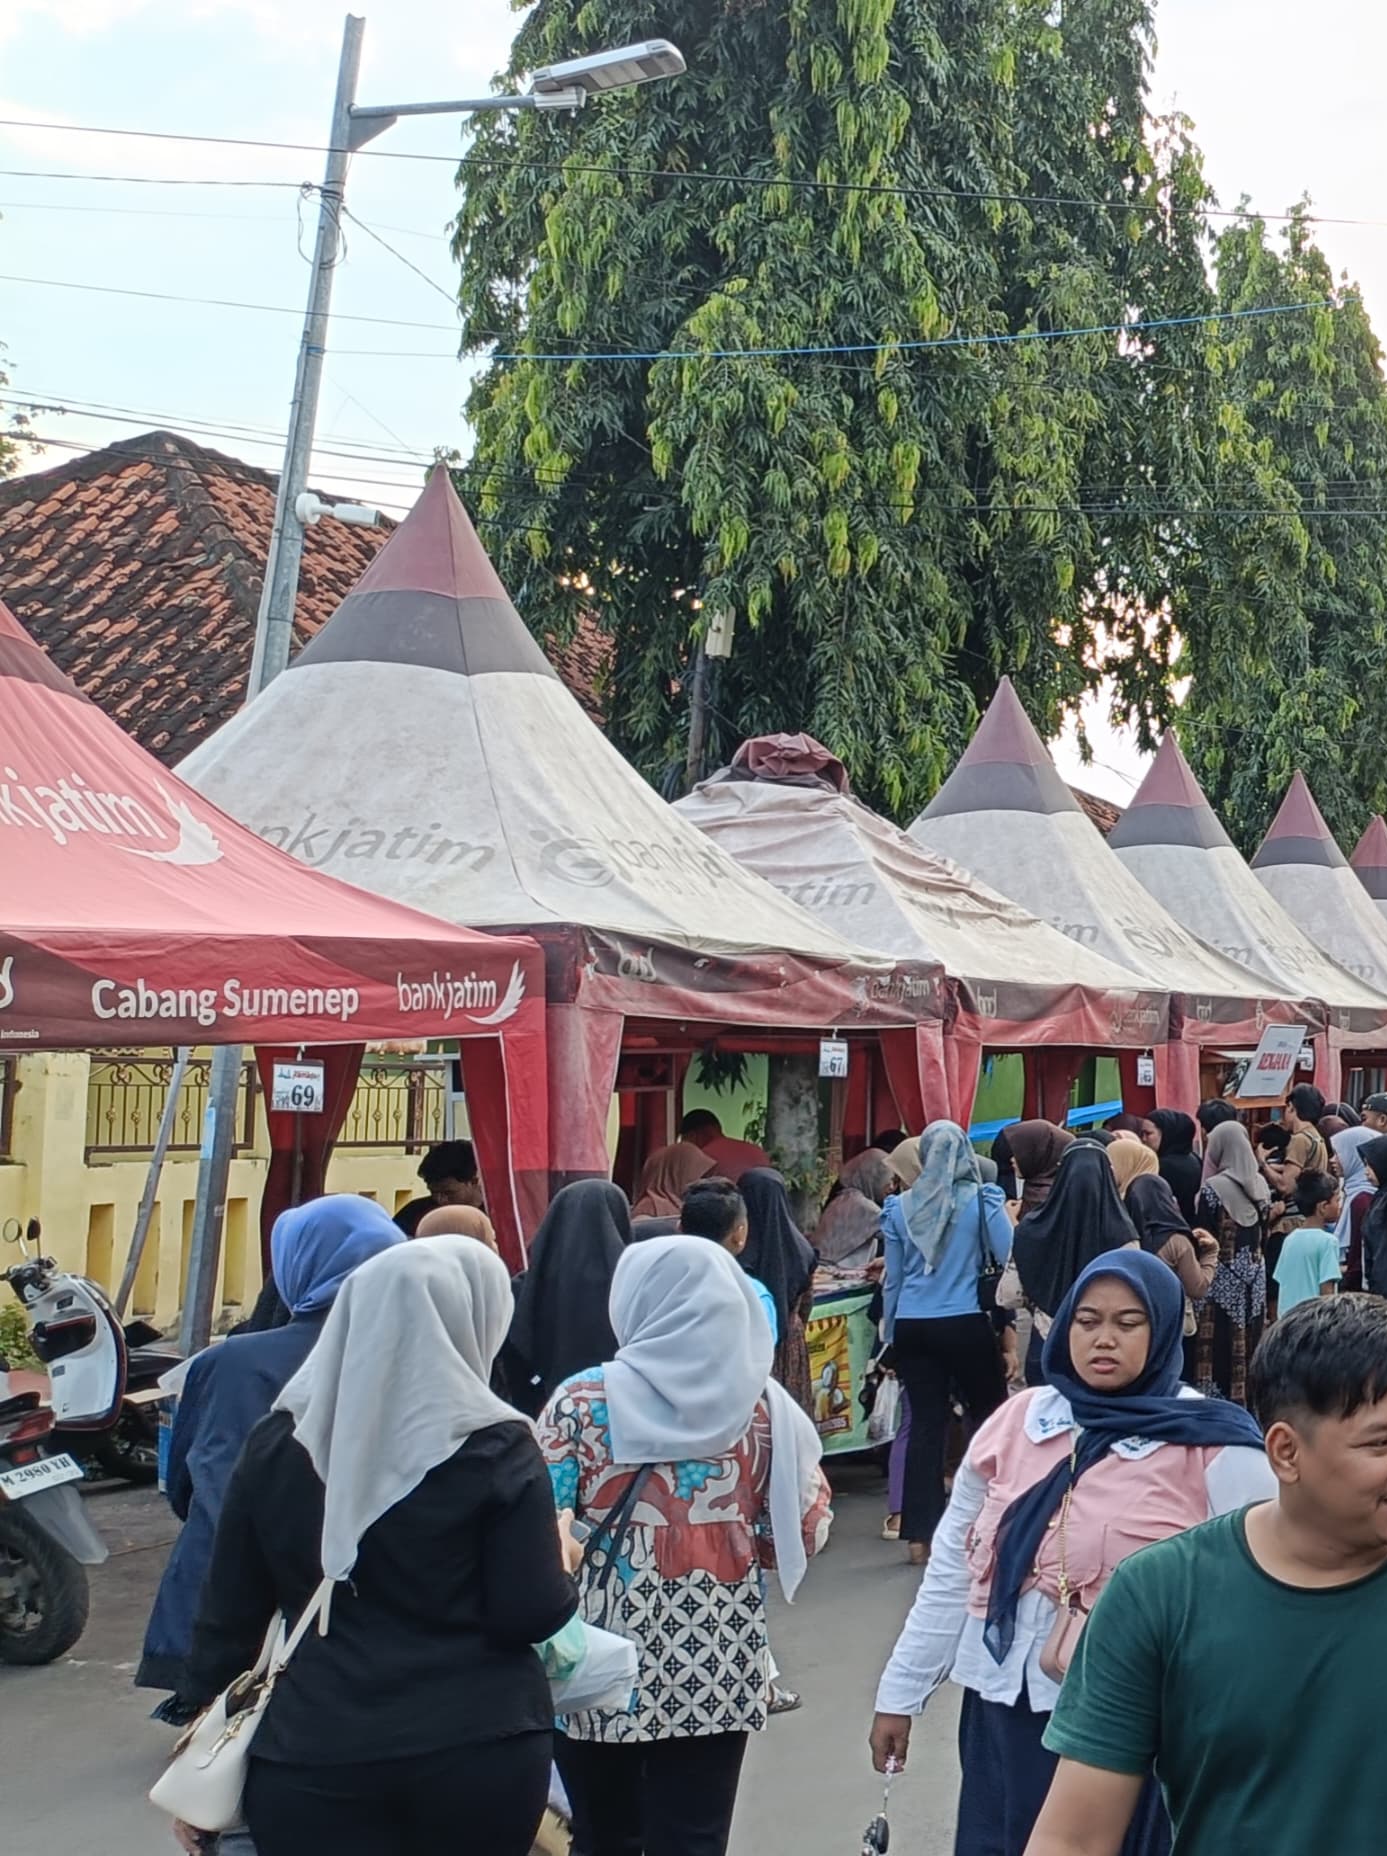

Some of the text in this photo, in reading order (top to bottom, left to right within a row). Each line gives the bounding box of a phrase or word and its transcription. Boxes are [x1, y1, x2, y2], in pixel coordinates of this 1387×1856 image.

[91, 978, 360, 1026] Cabang Sumenep
[396, 971, 497, 1020] bankjatim
[291, 1084, 315, 1107] 69
